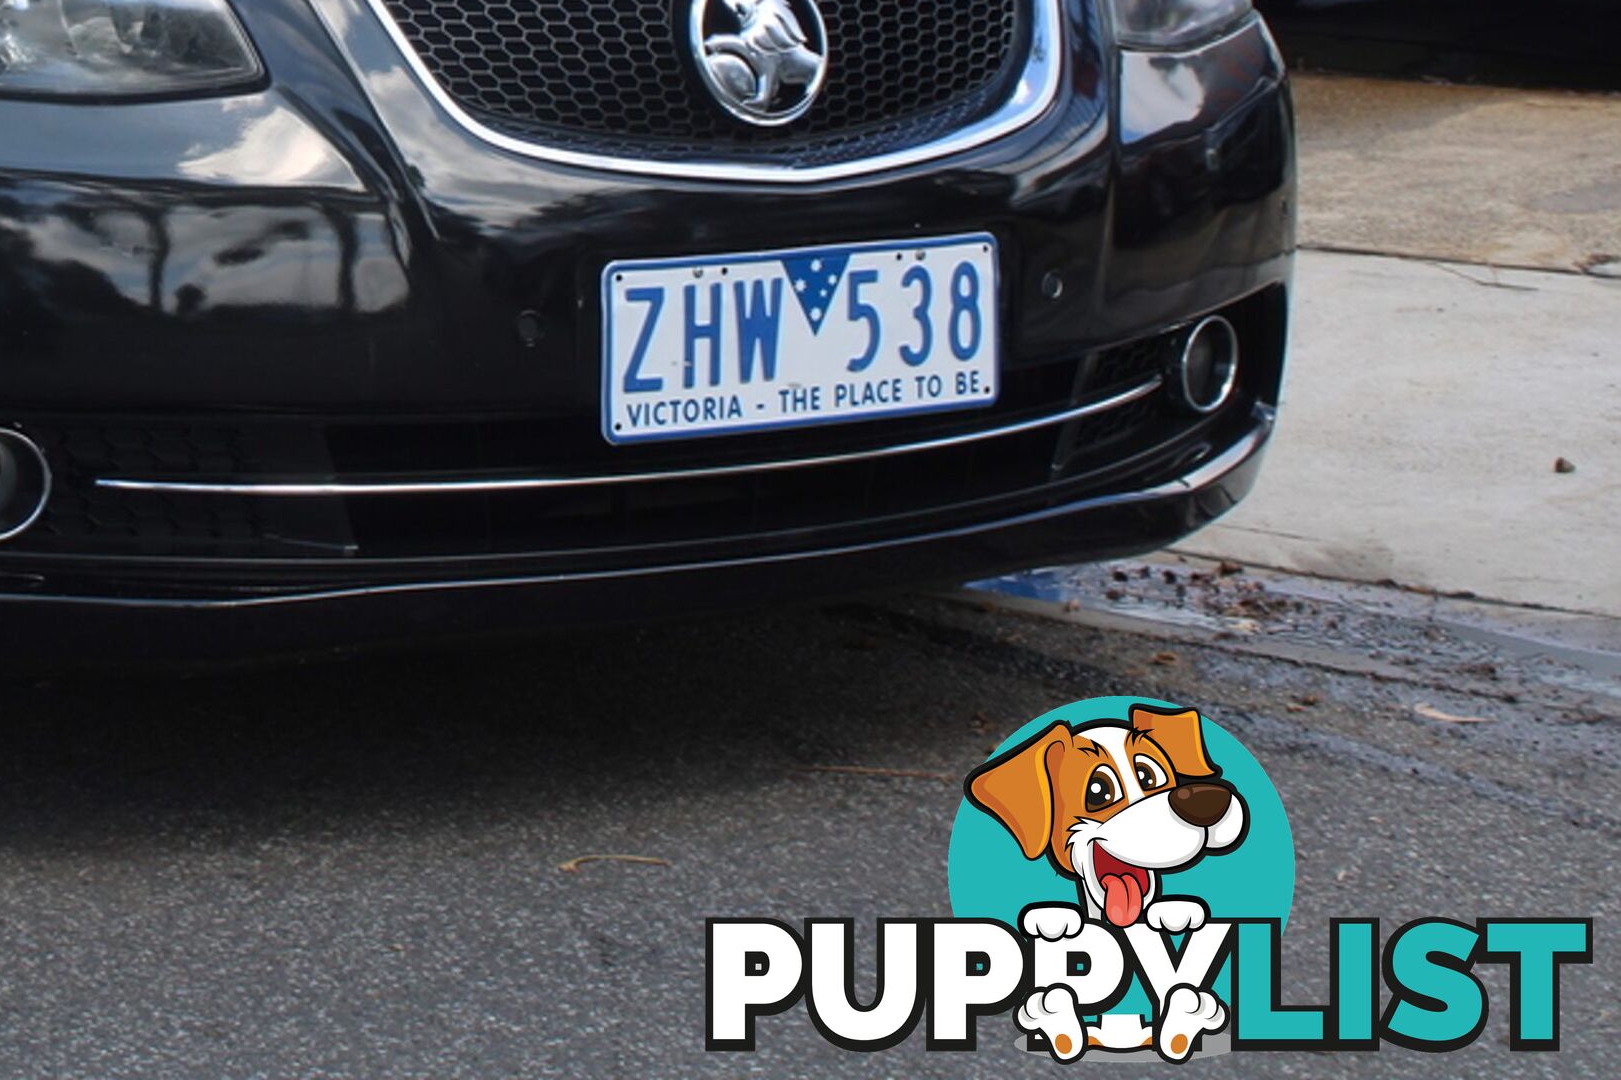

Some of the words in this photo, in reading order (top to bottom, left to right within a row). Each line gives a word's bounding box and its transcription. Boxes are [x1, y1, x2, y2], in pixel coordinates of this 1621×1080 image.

[622, 276, 784, 393] ZHW
[846, 260, 982, 373] 538
[625, 394, 742, 428] VICTORIA
[778, 386, 821, 415] THE
[833, 378, 903, 408] PLACE
[915, 374, 944, 399] TO
[954, 370, 981, 395] BE
